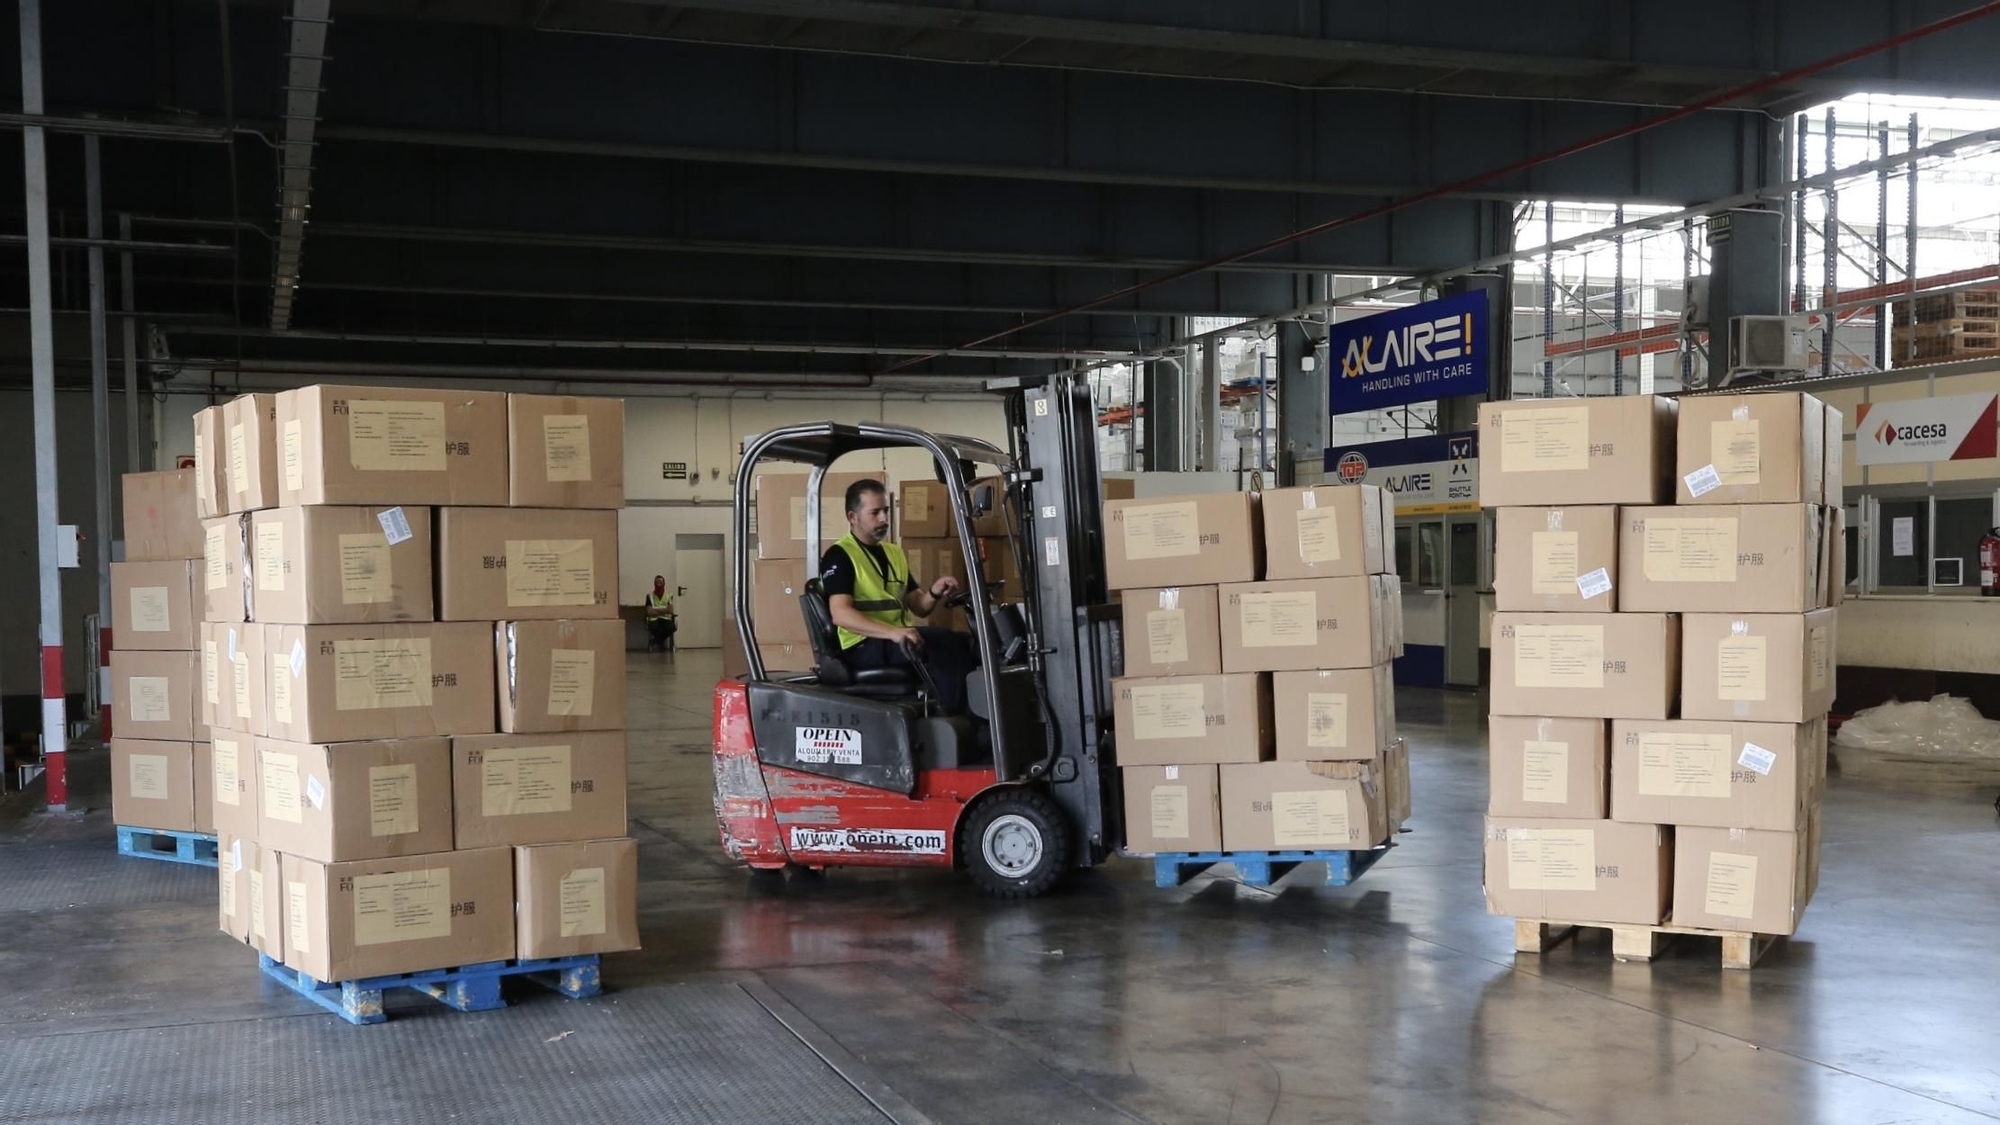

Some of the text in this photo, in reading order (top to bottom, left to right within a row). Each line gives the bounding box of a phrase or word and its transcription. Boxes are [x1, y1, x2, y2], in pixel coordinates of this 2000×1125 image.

[1362, 362, 1472, 393] HANDLING WITH CARE
[1898, 423, 1947, 440] cacesa
[1340, 461, 1365, 478] TOP
[803, 728, 853, 741] OPEIN
[797, 747, 831, 755] ALQUILER
